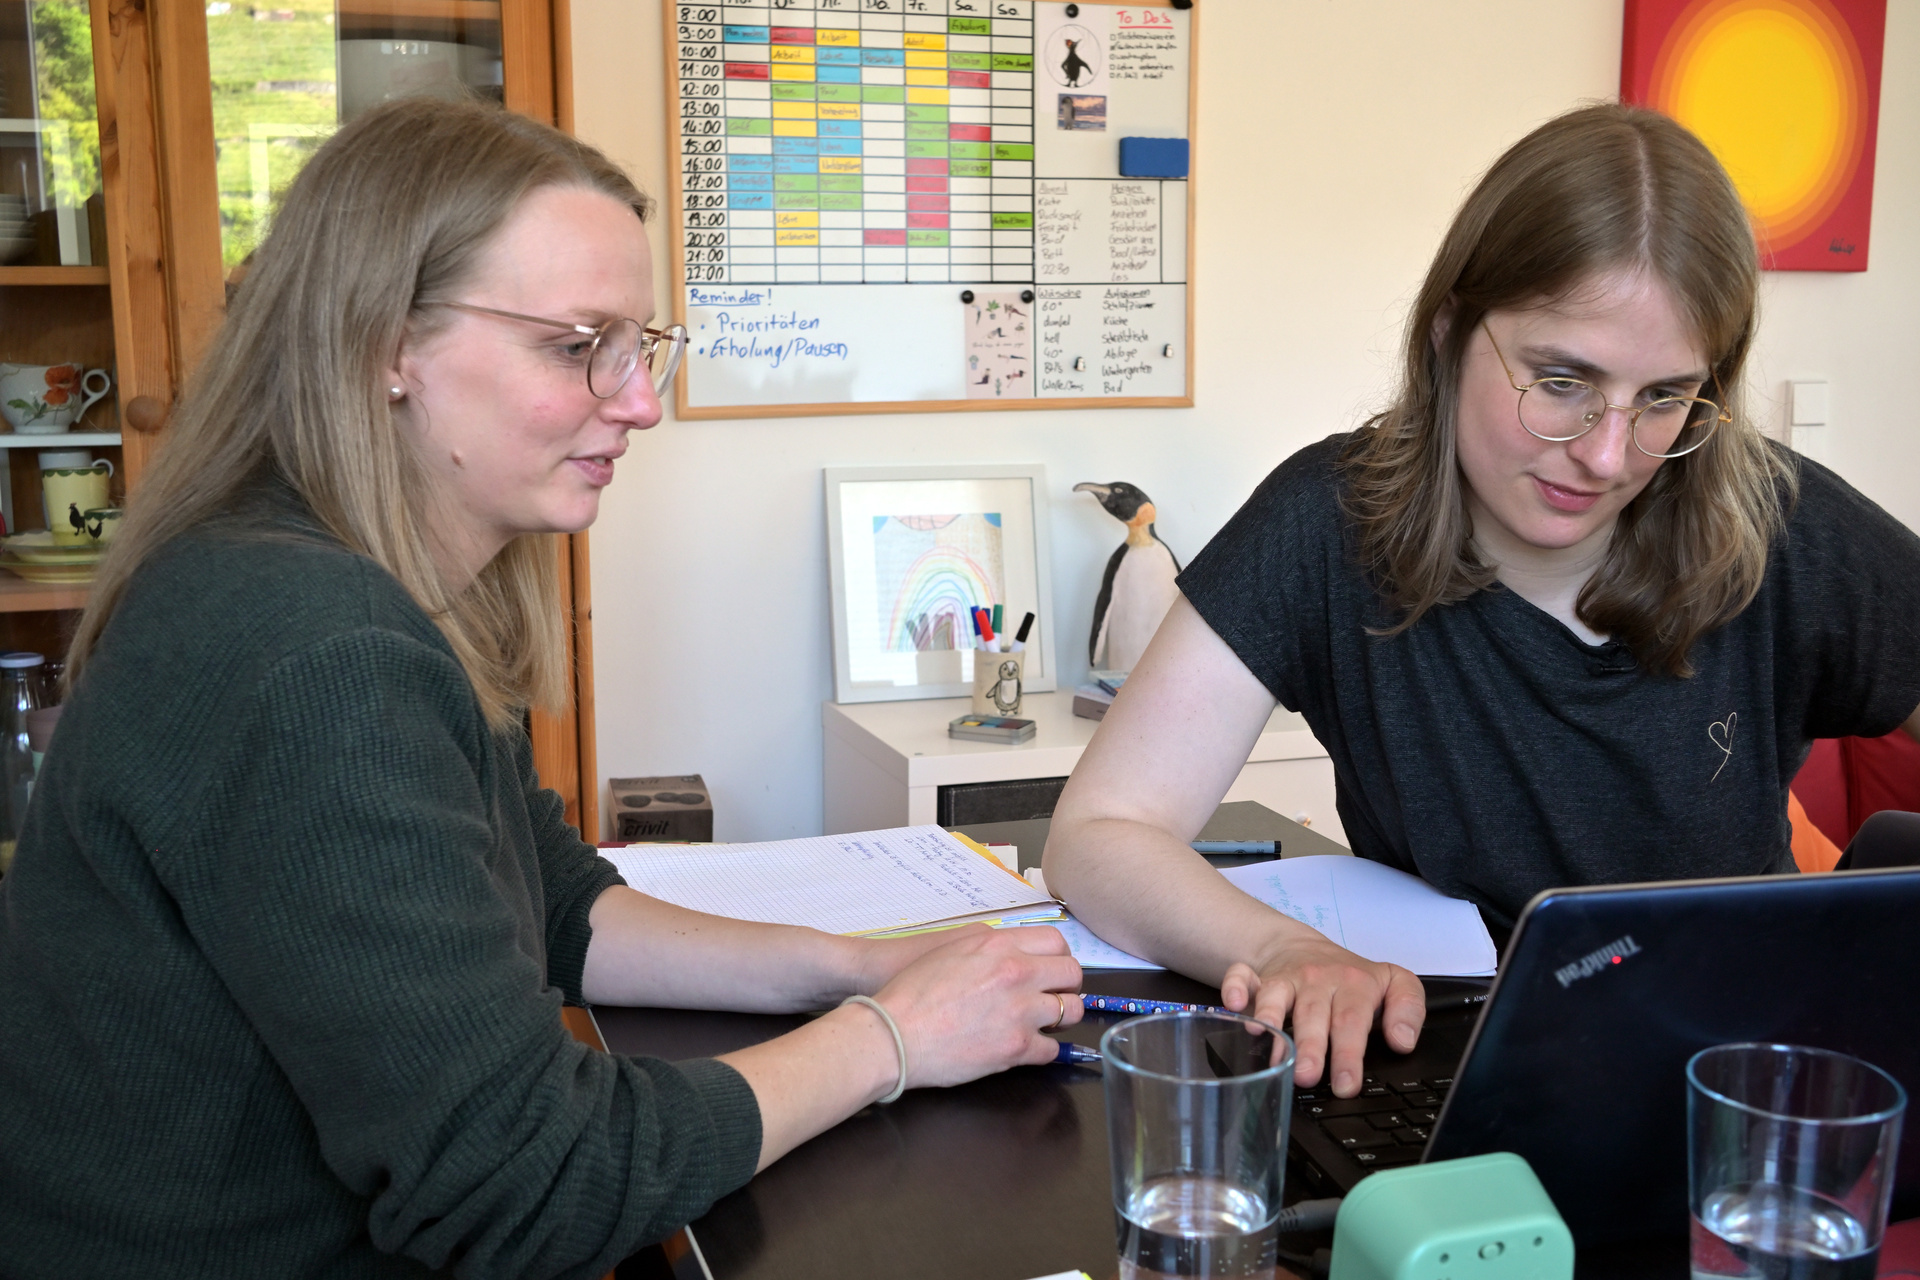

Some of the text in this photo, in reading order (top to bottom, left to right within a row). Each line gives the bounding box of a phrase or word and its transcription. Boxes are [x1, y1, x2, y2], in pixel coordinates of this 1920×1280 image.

[681, 7, 716, 22] 8:00
[1116, 10, 1133, 23] To
[679, 26, 716, 40] 9:00
[681, 46, 717, 58] 10:00
[680, 63, 720, 77] 11:00
[681, 82, 720, 97] 12:00
[681, 101, 720, 116] 13:00
[682, 120, 722, 134] 14:00
[684, 139, 722, 154] 15:00
[684, 158, 723, 173] 16:00
[685, 175, 723, 191] 17:00
[685, 195, 724, 209] 18:00
[687, 212, 725, 227] 19:00
[686, 232, 725, 247] 20:00
[686, 249, 724, 263] 21:00
[686, 266, 724, 281] 22:00
[689, 287, 772, 306] Reminder!
[1038, 288, 1082, 298] Wäsche
[1041, 301, 1063, 311] 60°
[716, 311, 820, 333] Prioritäten
[1103, 316, 1129, 326] Küche
[1043, 332, 1061, 344] hell
[710, 336, 848, 369] Erholung/Pausen
[1103, 380, 1123, 393] Bad
[1554, 934, 1641, 988] ThinkPad
